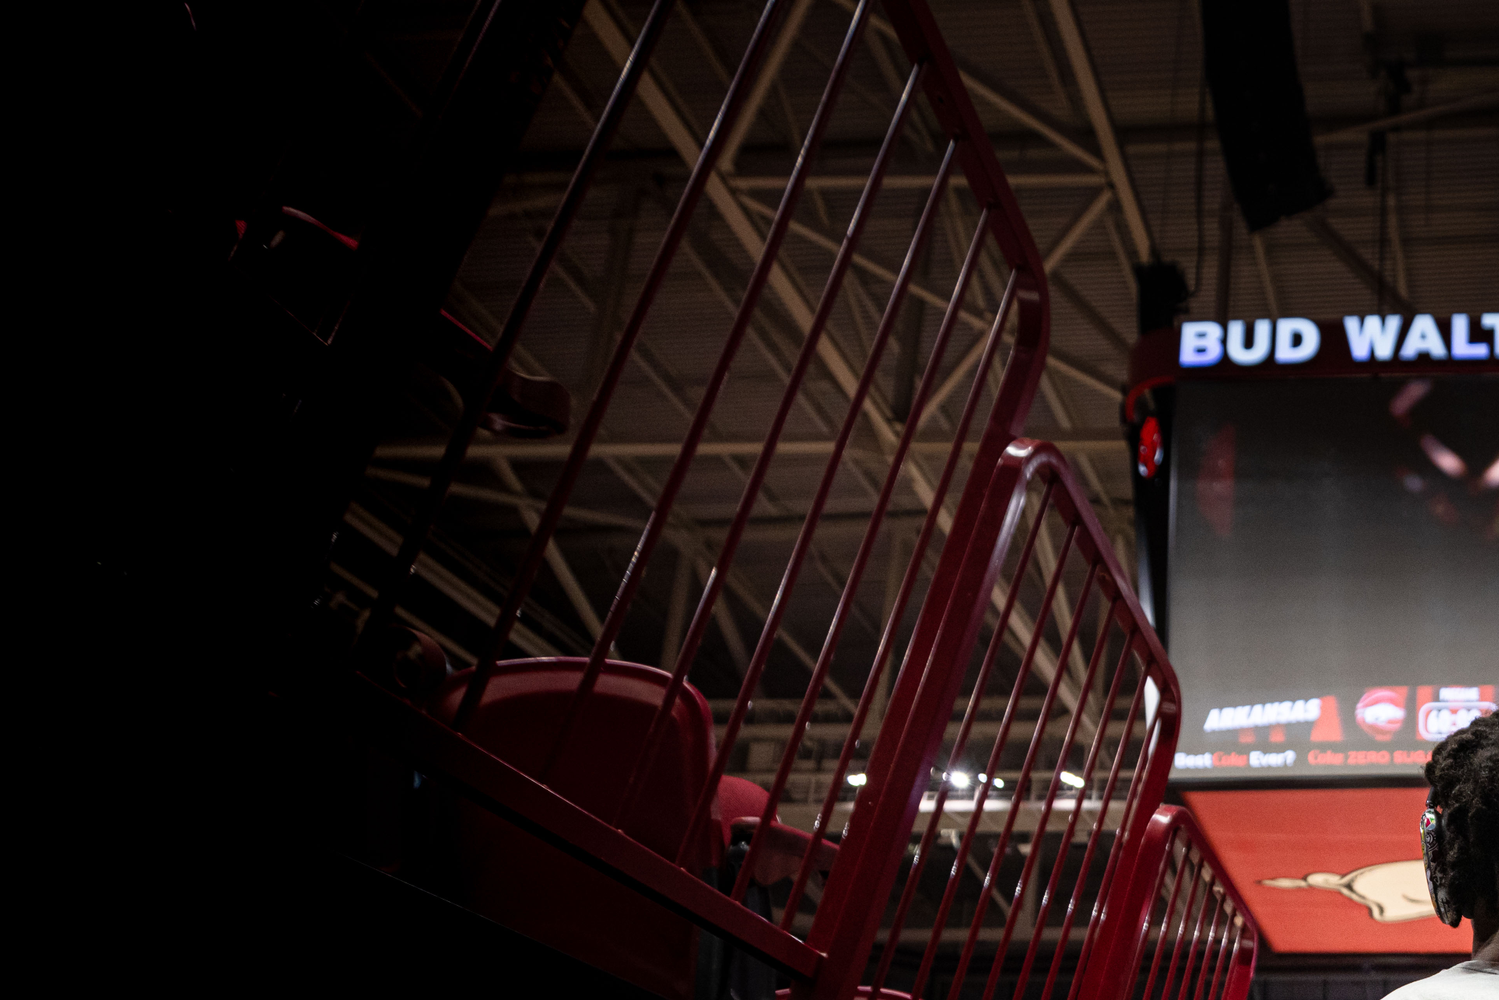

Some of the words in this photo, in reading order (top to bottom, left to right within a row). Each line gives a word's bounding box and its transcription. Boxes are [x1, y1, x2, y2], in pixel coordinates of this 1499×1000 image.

[1179, 317, 1321, 368] BUD
[1203, 697, 1322, 733] ARKANSAS
[1173, 751, 1212, 769] Best
[1249, 749, 1297, 768] Ever?
[1347, 750, 1391, 765] ZERO
[1393, 749, 1433, 765] SUG
